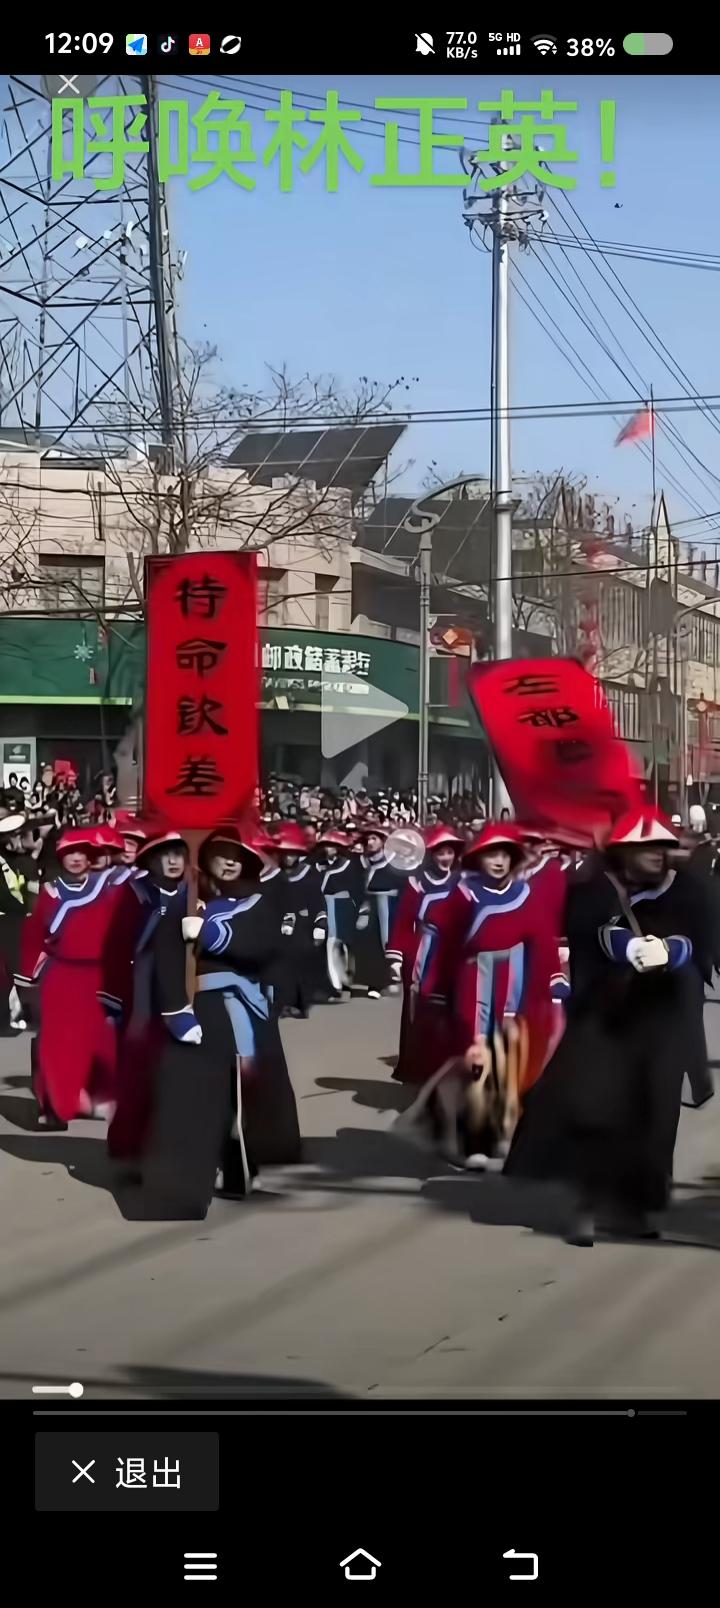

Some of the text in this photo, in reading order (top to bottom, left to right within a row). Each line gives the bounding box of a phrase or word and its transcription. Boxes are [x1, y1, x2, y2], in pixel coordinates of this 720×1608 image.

[45, 32, 114, 54] 12:09
[446, 32, 478, 45] 77.0
[488, 33, 521, 43] 5G HD
[446, 47, 478, 60] KB/s
[566, 38, 615, 57] 38%
[115, 1456, 181, 1489] 退出
